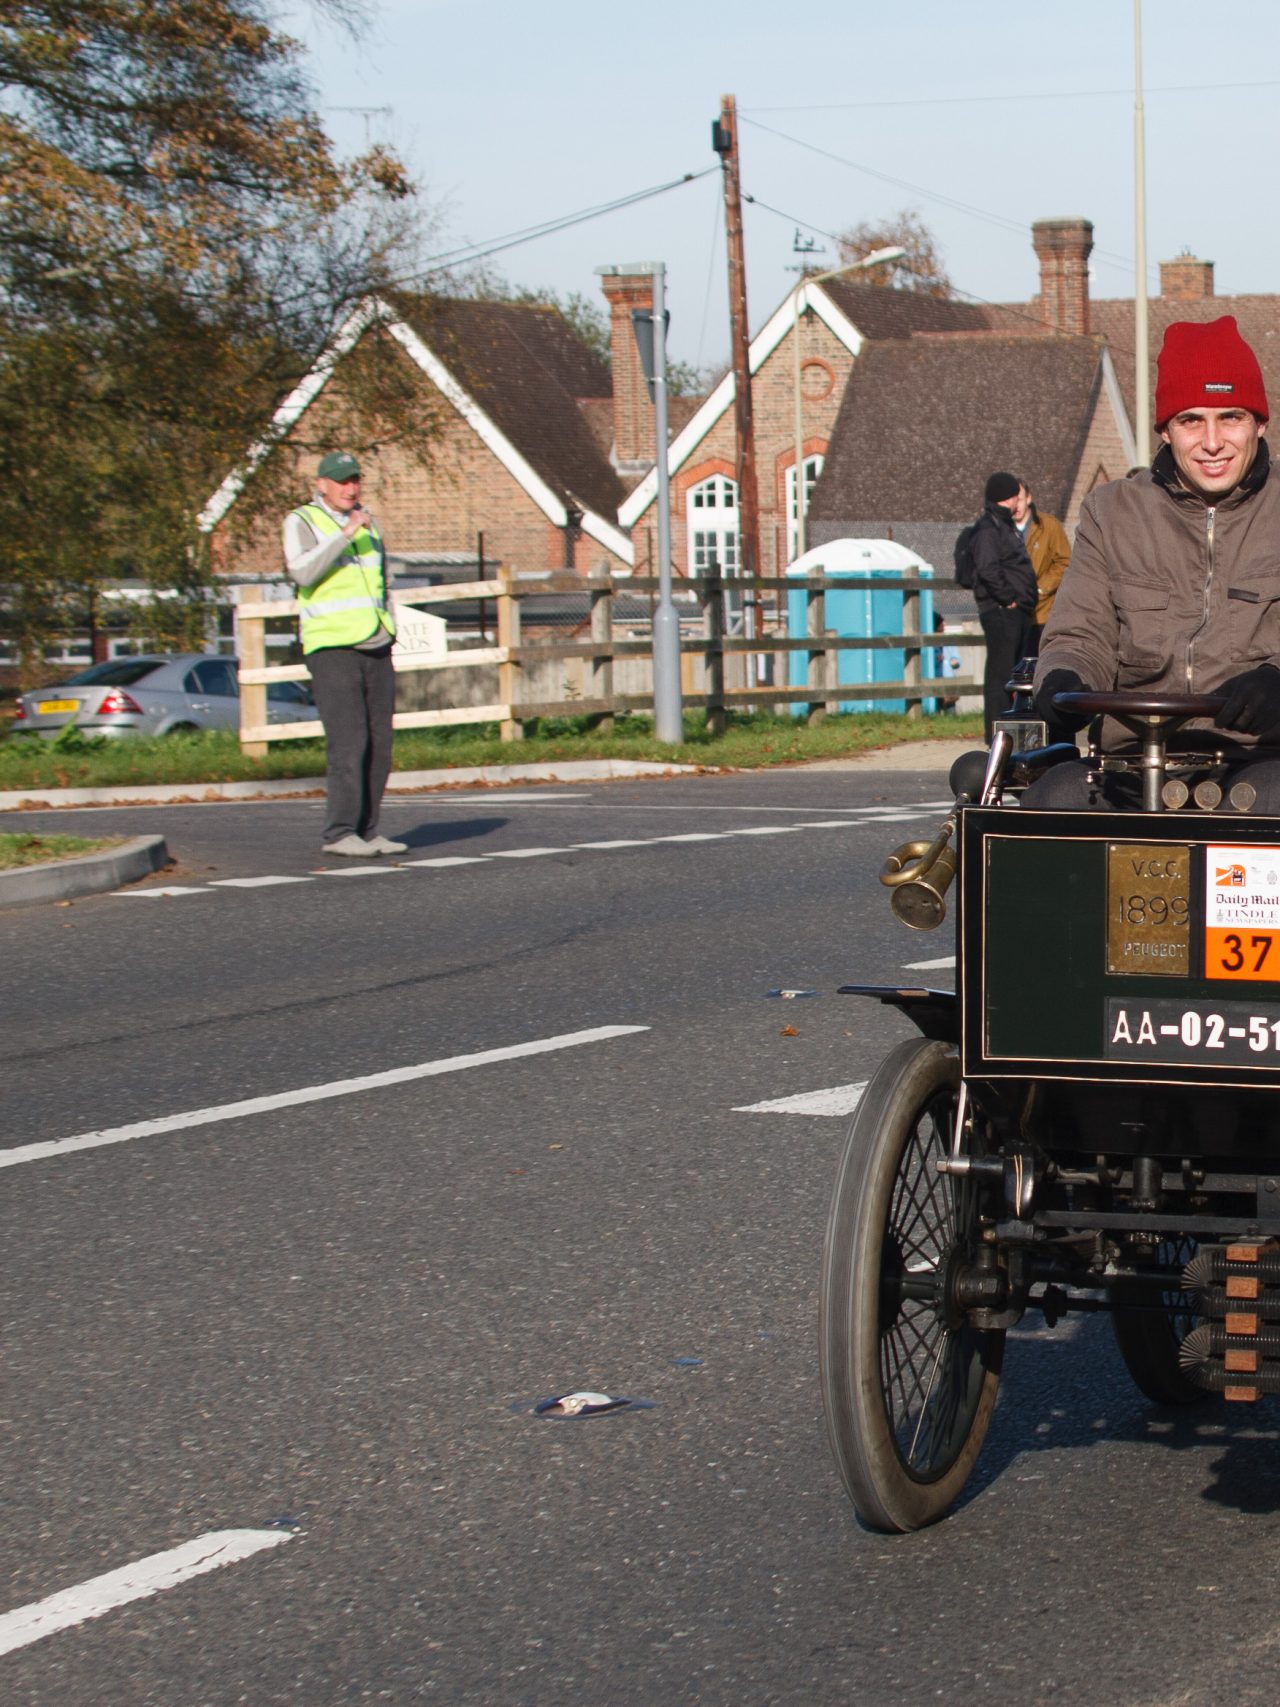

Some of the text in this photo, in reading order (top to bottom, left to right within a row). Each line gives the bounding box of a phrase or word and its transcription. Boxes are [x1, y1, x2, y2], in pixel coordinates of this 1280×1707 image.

[1215, 893, 1280, 908] Daily Mail
[1119, 895, 1190, 927] 1899
[1227, 908, 1279, 918] TINDLE
[1123, 942, 1187, 959] PEUGEOT
[1220, 933, 1274, 973] 37
